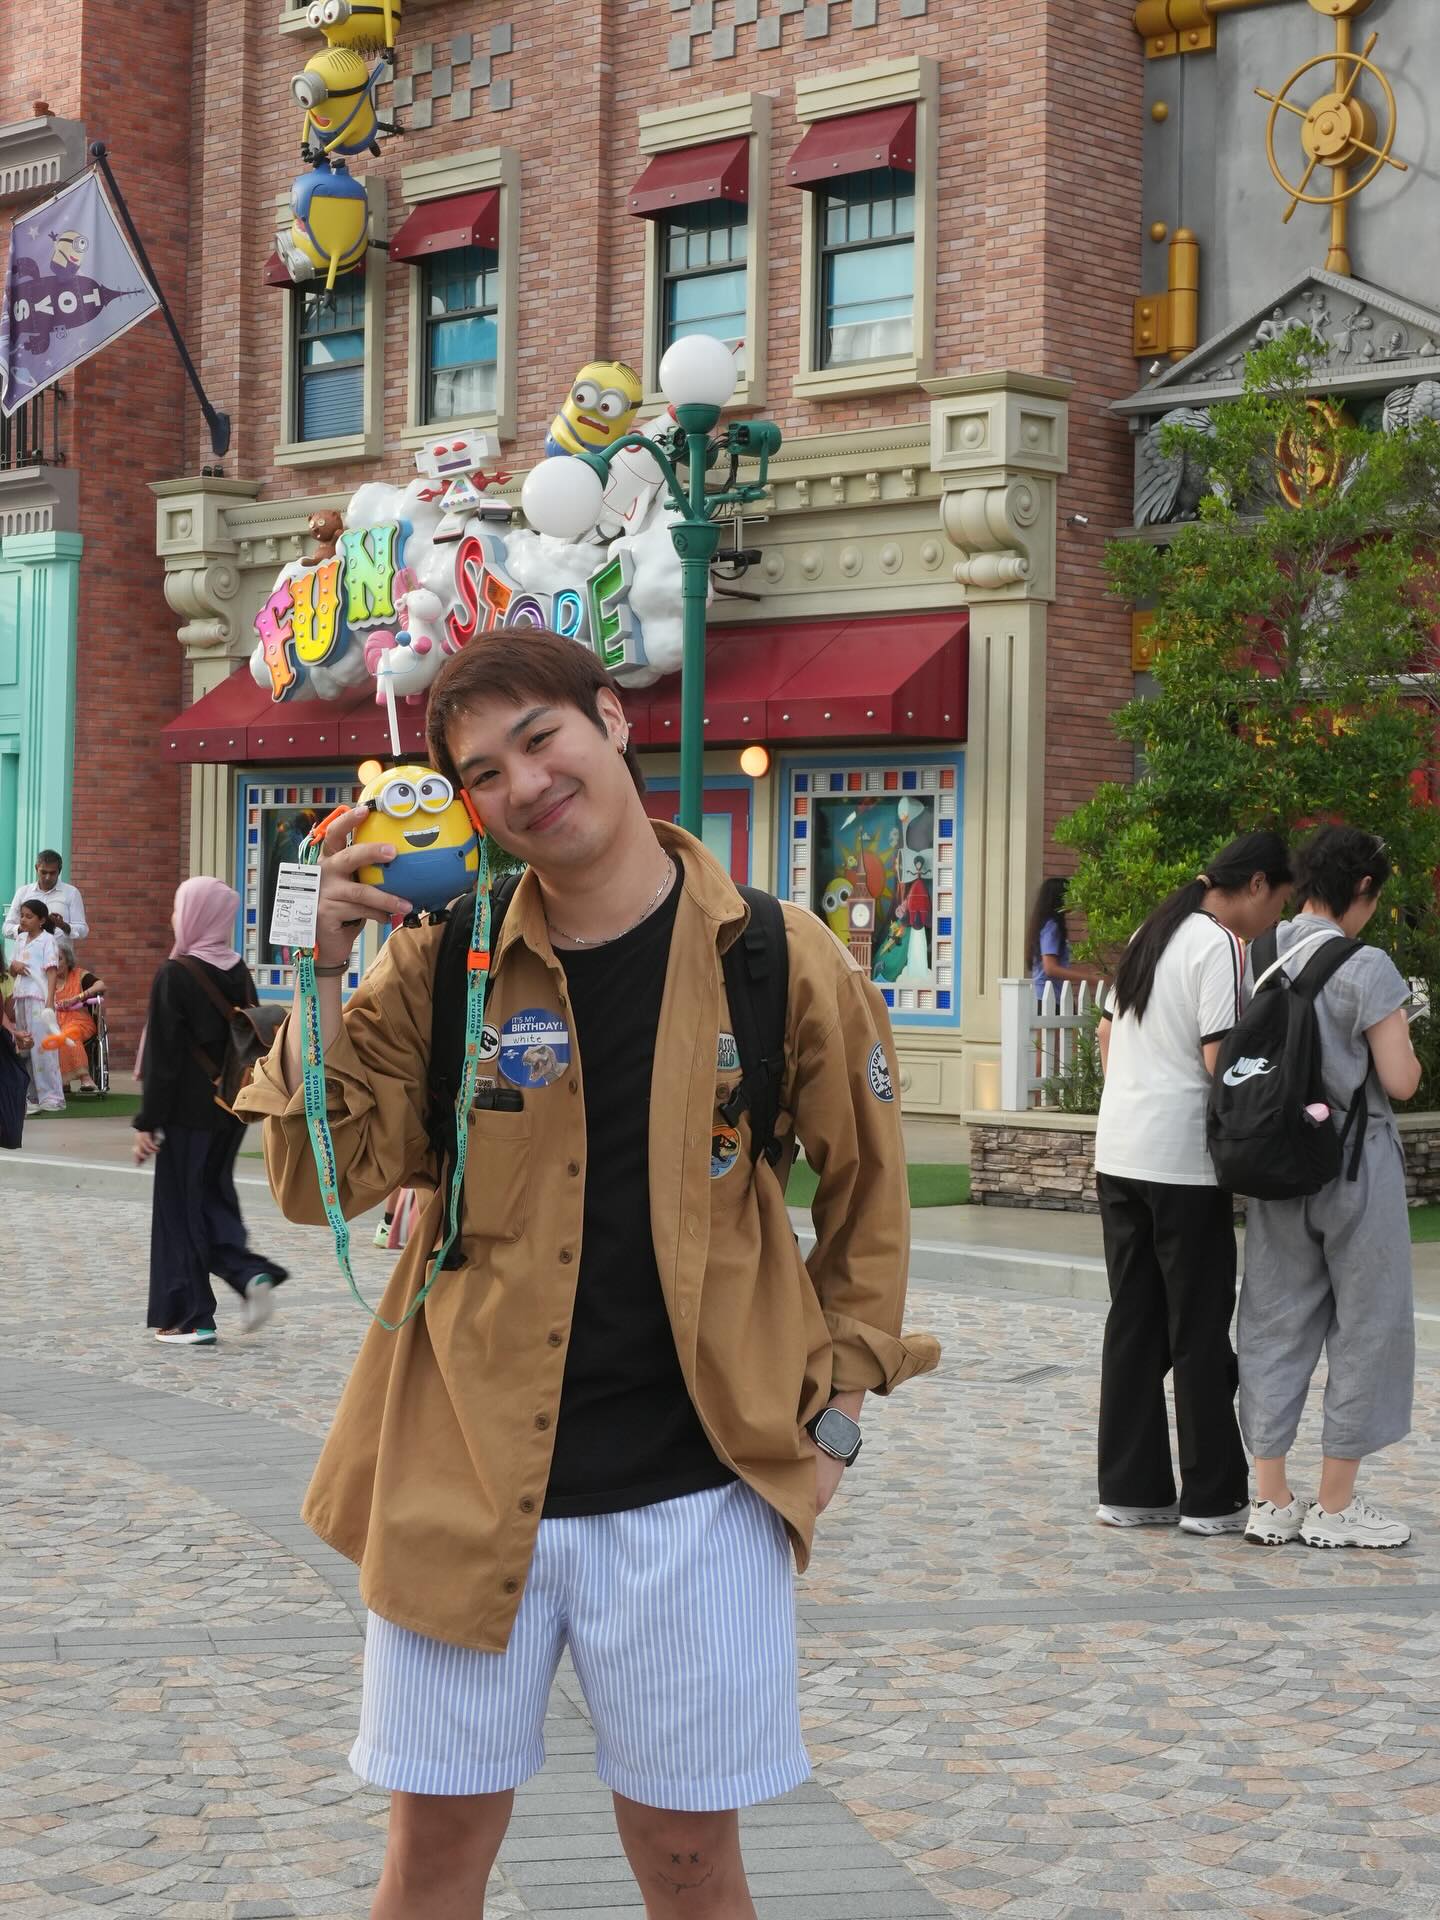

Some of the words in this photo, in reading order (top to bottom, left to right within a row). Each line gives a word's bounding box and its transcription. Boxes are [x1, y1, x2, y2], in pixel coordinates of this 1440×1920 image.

[13, 288, 101, 323] TOYS
[253, 524, 397, 701] FUN
[474, 993, 482, 1041] UNIVERSAL
[511, 1021, 563, 1033] BIRTHDAY!
[525, 1015, 536, 1023] MY
[513, 1034, 543, 1044] white
[871, 1051, 881, 1089] RAPTOR
[1232, 1056, 1269, 1075] NIKE
[305, 1070, 313, 1117] UNIVERSAL
[312, 1074, 320, 1111] STUDIOS
